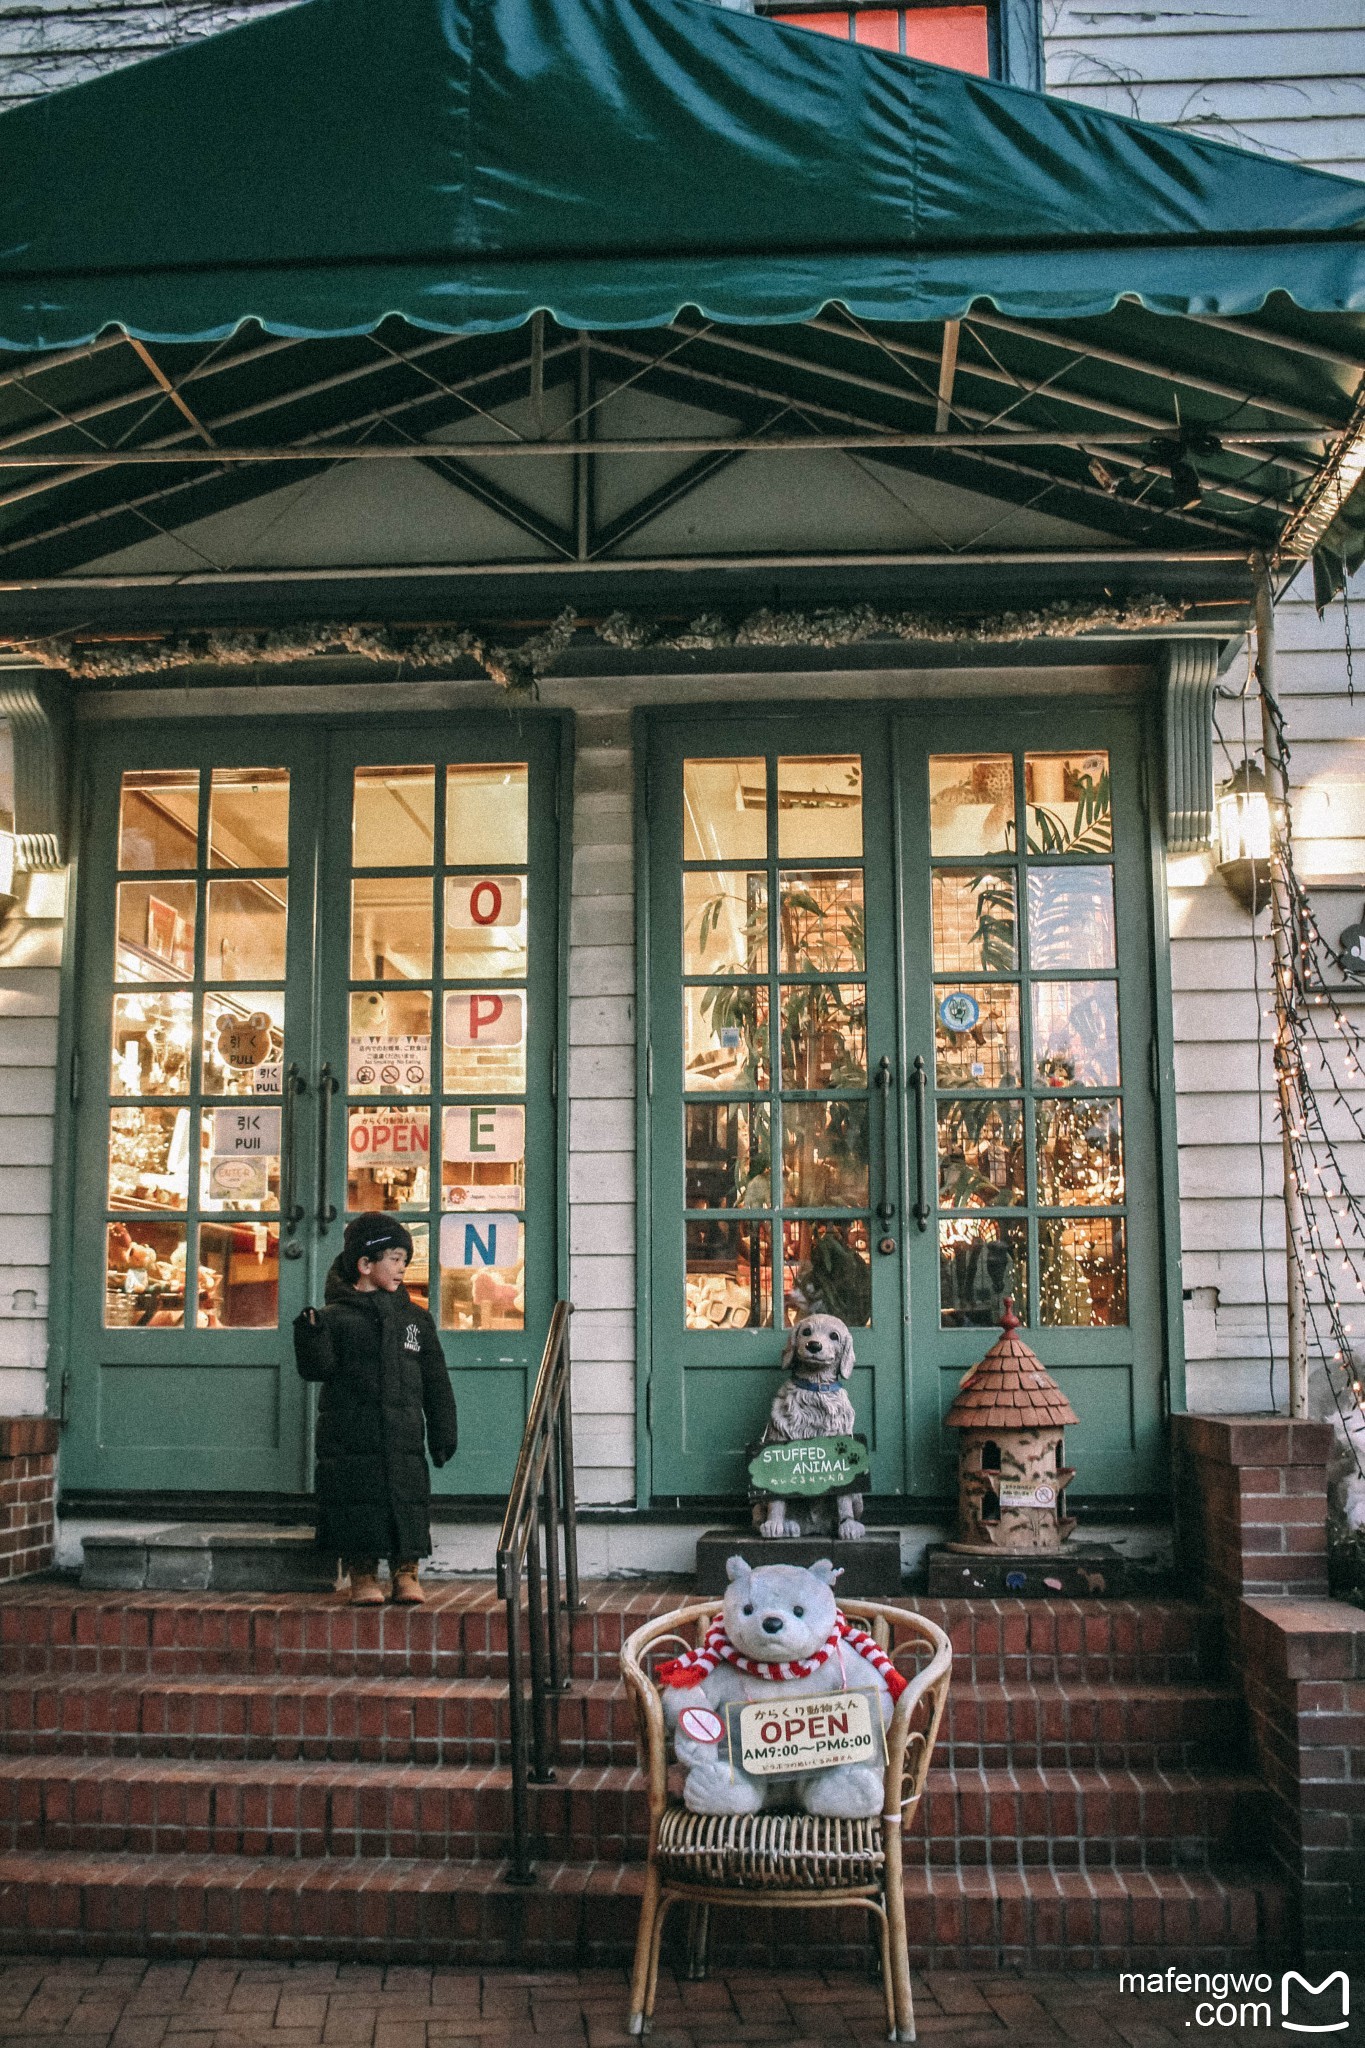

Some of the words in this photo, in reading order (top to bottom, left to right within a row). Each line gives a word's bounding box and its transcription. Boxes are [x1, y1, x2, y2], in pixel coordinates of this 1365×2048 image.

[230, 1035, 256, 1048] 引く
[230, 1055, 255, 1064] PULL
[260, 1068, 277, 1078] 引く
[256, 1083, 279, 1092] PULL
[238, 1116, 260, 1130] 引く
[350, 1124, 429, 1153] OPEN
[763, 1447, 826, 1463] STUFFED
[793, 1459, 850, 1474] ANIMAL
[754, 1700, 858, 1720] からくり動物えん
[760, 1713, 849, 1743] OPEN
